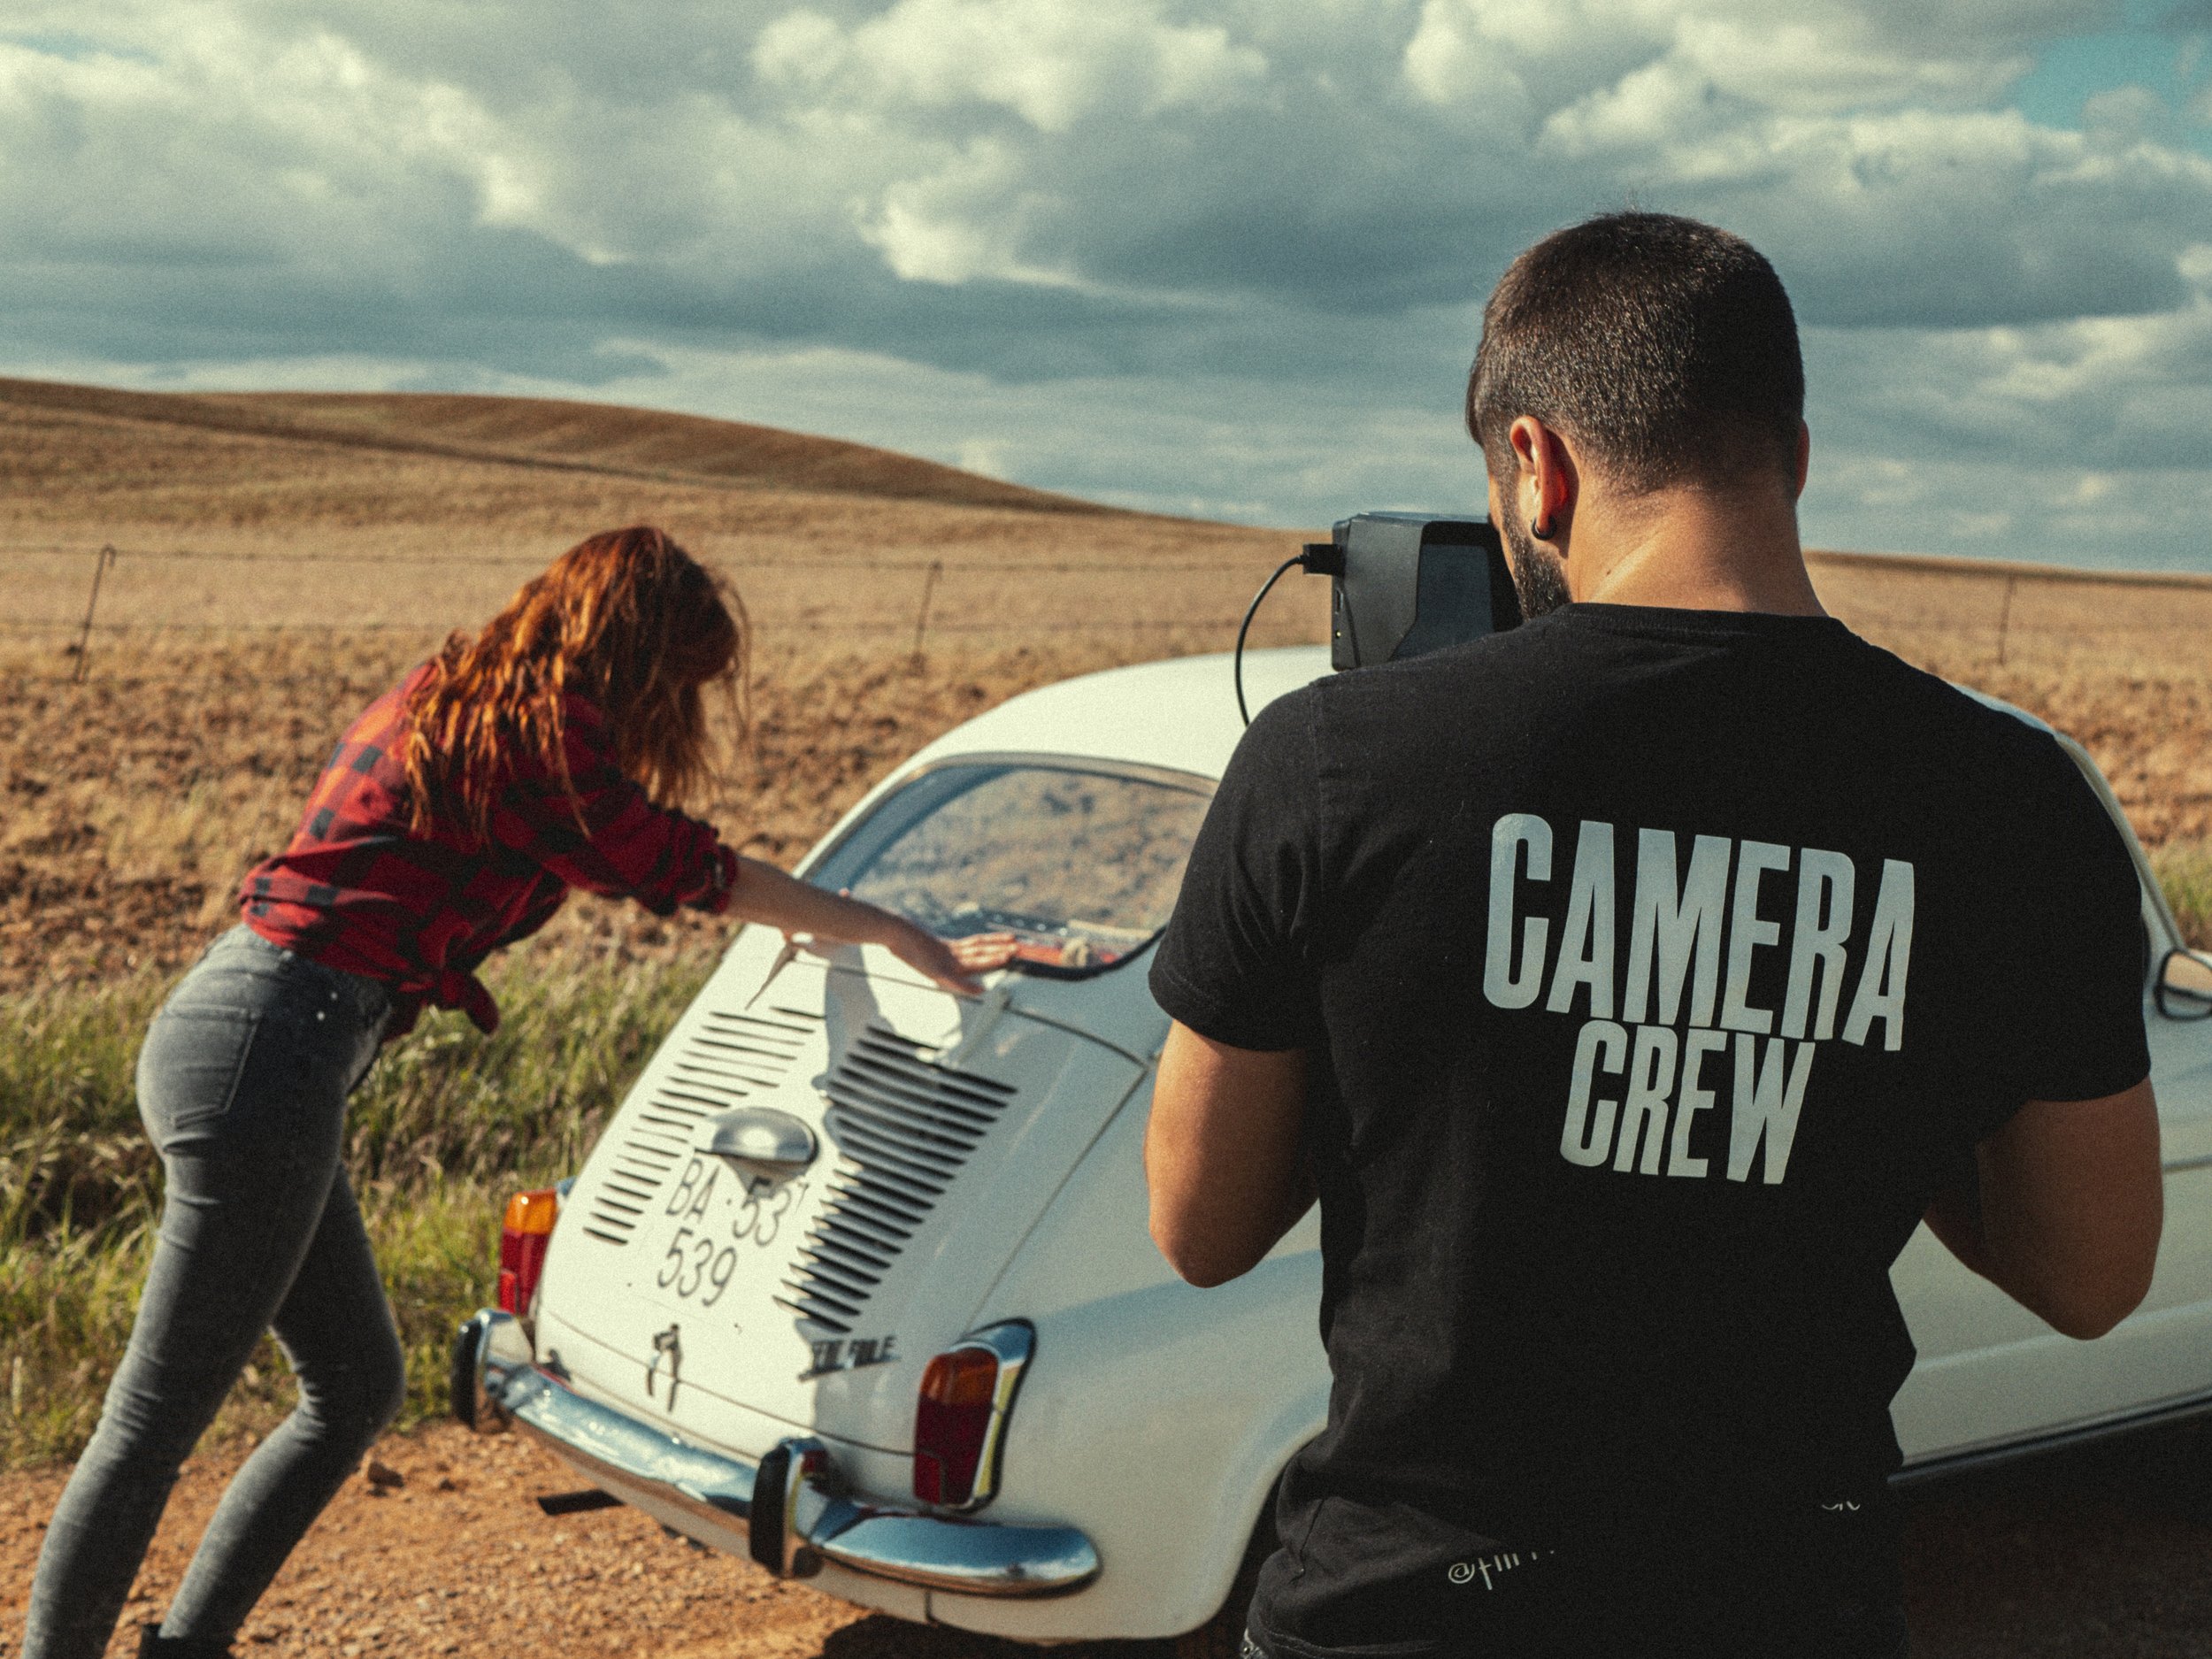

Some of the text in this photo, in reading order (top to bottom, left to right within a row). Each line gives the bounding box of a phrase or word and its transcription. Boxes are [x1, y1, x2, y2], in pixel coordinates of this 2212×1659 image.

[1483, 812, 1916, 1052] CAMERA
[1559, 1019, 1816, 1185] CREW
[664, 1157, 721, 1225] BA
[657, 1226, 737, 1308] 539
